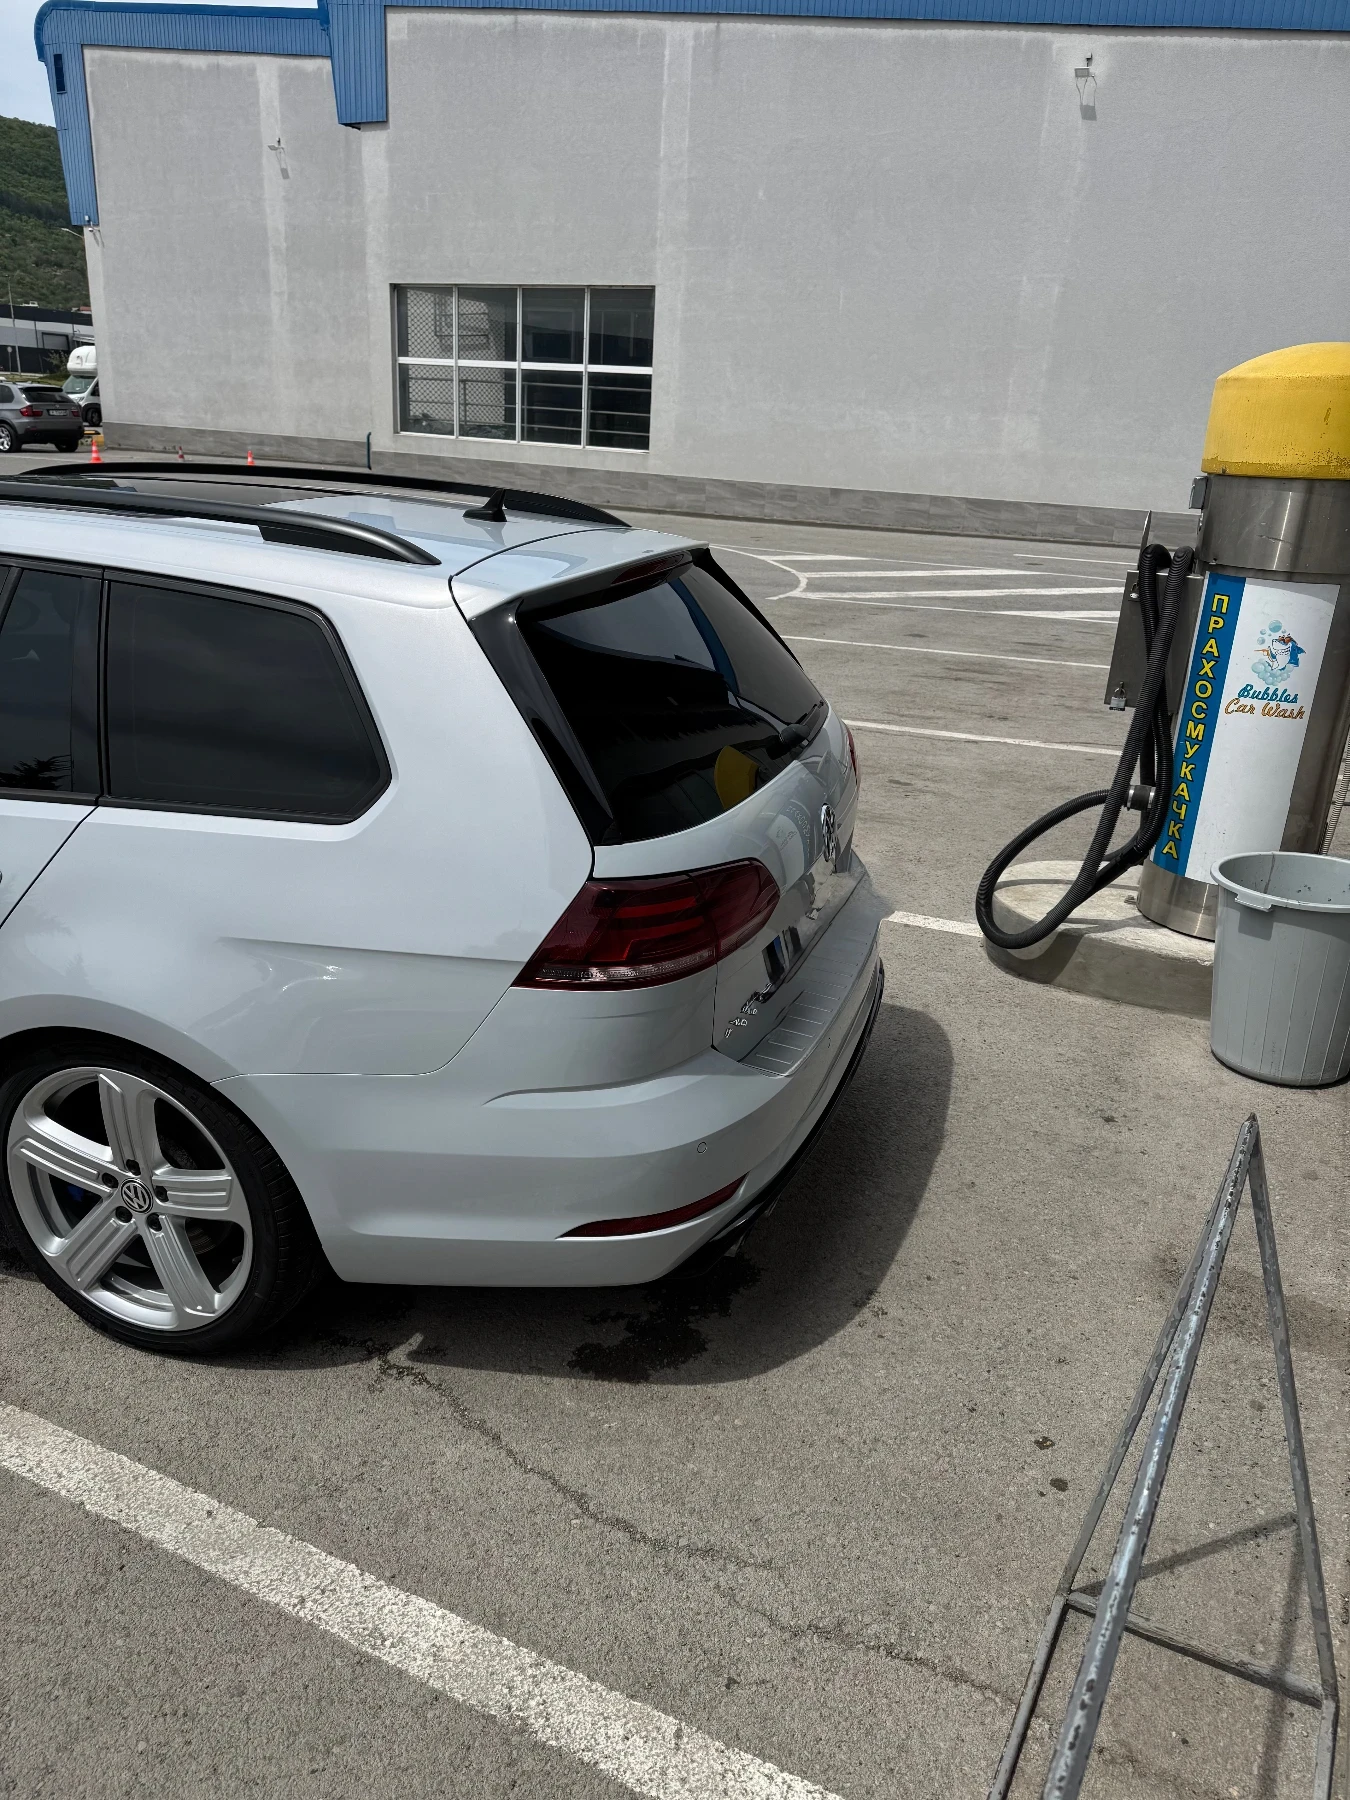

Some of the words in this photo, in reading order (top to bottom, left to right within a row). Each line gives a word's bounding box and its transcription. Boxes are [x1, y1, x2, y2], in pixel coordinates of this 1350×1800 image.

[1238, 684, 1298, 704] Bubbles
[1225, 698, 1256, 715] Car
[1261, 702, 1305, 719] Wash
[1161, 594, 1230, 860] ПРАХОСМУКАЧКА
